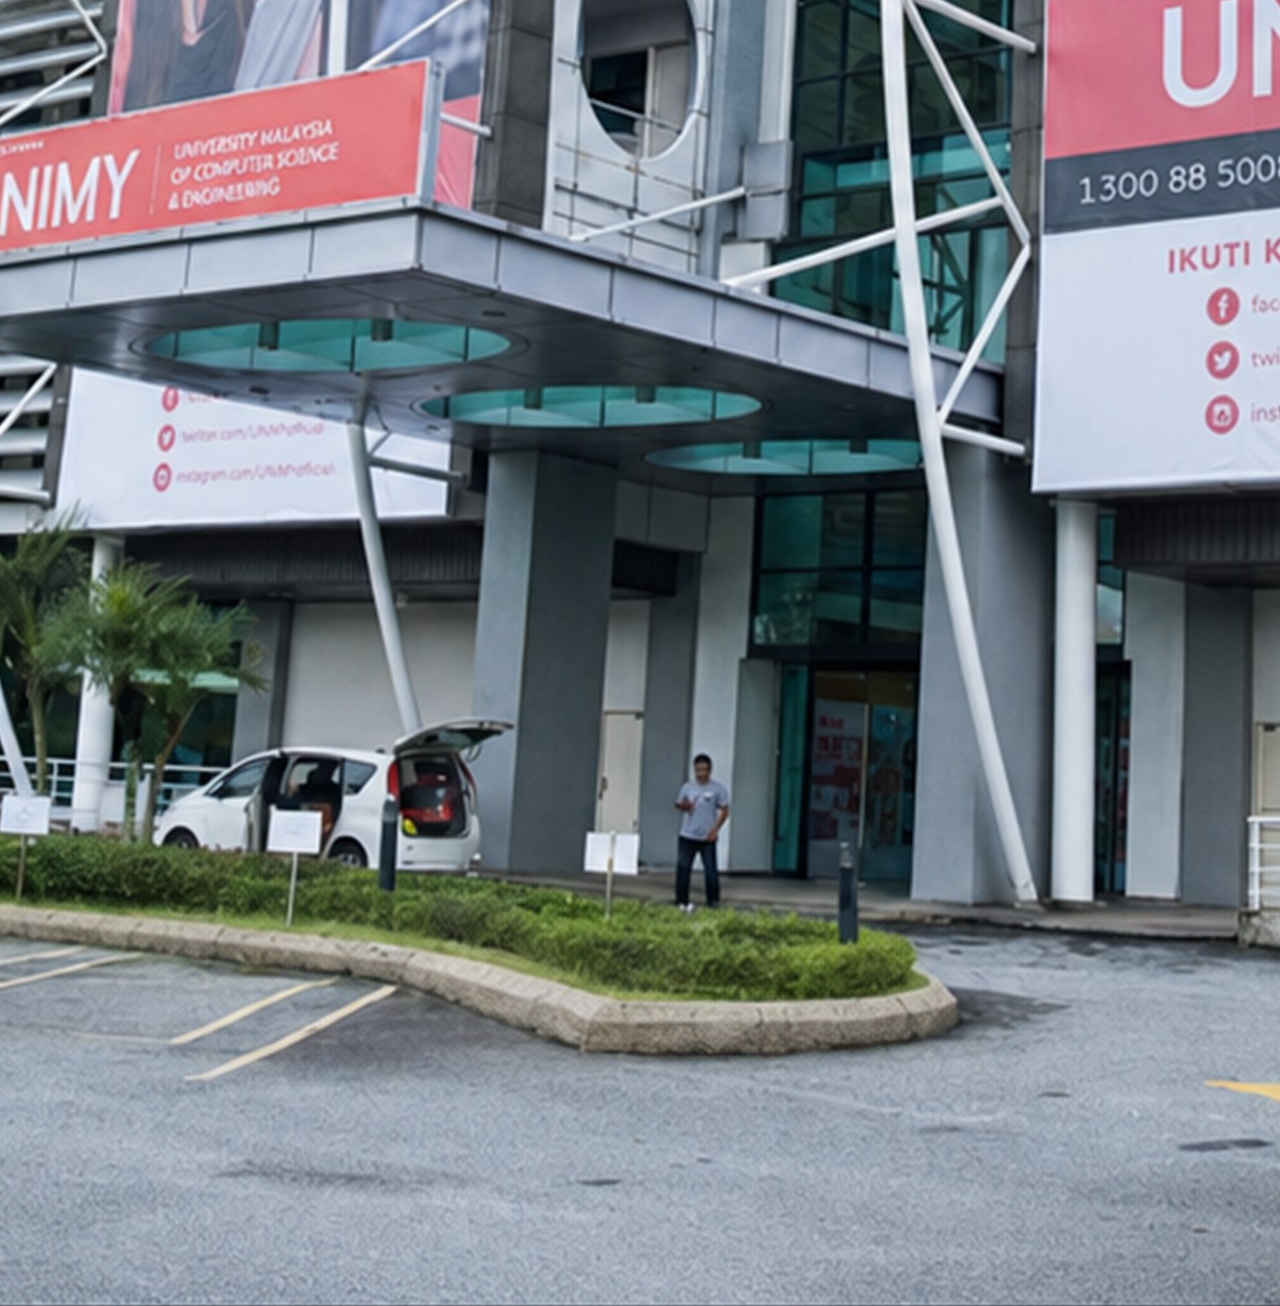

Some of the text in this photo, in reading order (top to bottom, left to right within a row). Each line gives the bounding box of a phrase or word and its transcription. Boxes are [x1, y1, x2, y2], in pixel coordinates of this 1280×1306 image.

[174, 118, 333, 160] UNIVERSITY MALAYSIA
[193, 154, 274, 182] COMPUTER
[277, 141, 340, 169] SCIENCE
[182, 176, 281, 209] ENGINEERING
[1079, 168, 1158, 205] 1300
[1168, 162, 1207, 193] 88
[1168, 240, 1251, 274] IKUTI
